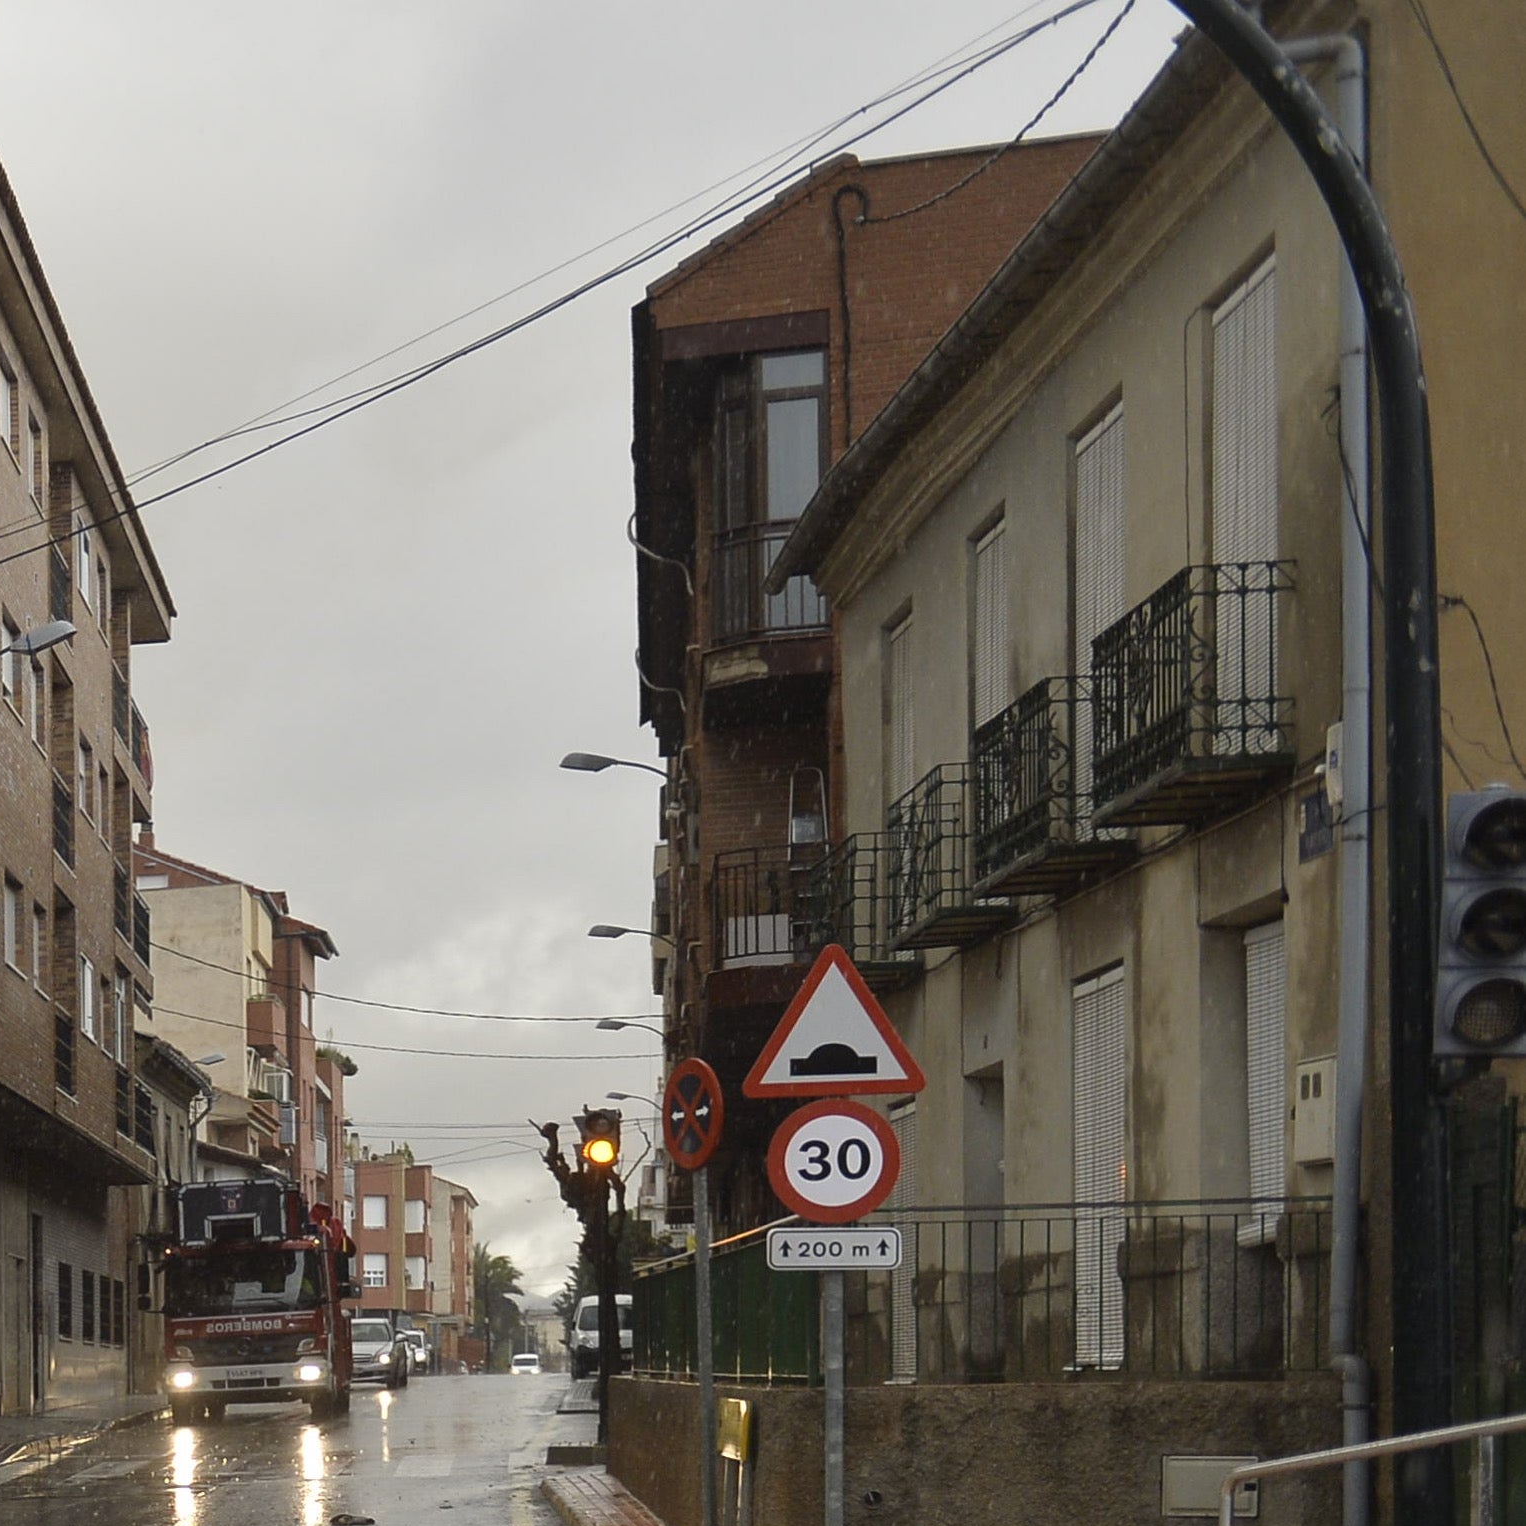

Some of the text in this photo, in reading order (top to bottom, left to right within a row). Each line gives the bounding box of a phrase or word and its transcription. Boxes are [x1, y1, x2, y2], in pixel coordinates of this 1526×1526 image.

[797, 1138, 871, 1182] 30
[798, 1241, 870, 1258] 200 m
